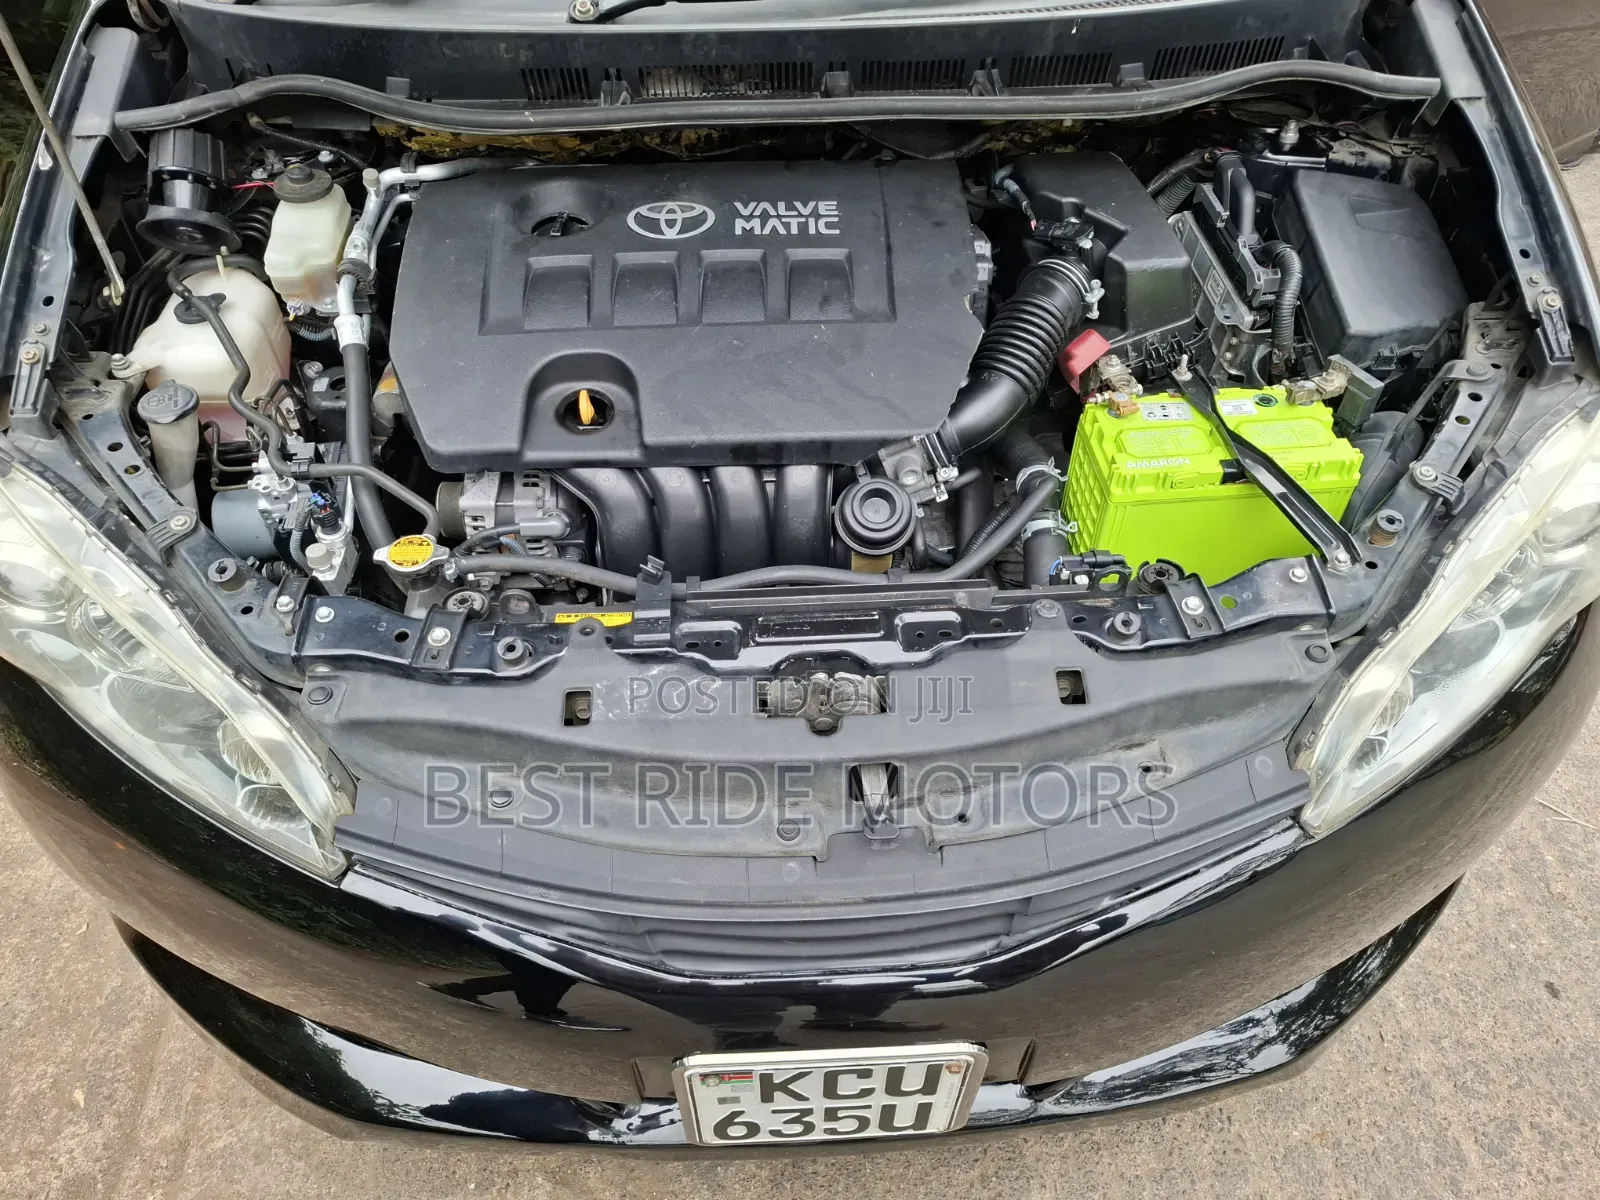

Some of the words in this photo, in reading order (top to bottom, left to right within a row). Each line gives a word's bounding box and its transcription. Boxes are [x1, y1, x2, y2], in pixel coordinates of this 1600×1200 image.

[733, 200, 839, 216] VALVE
[734, 217, 840, 235] MATIC
[1126, 456, 1191, 469] AMARON
[759, 1062, 943, 1103] KCU
[712, 1101, 934, 1141] 635U
